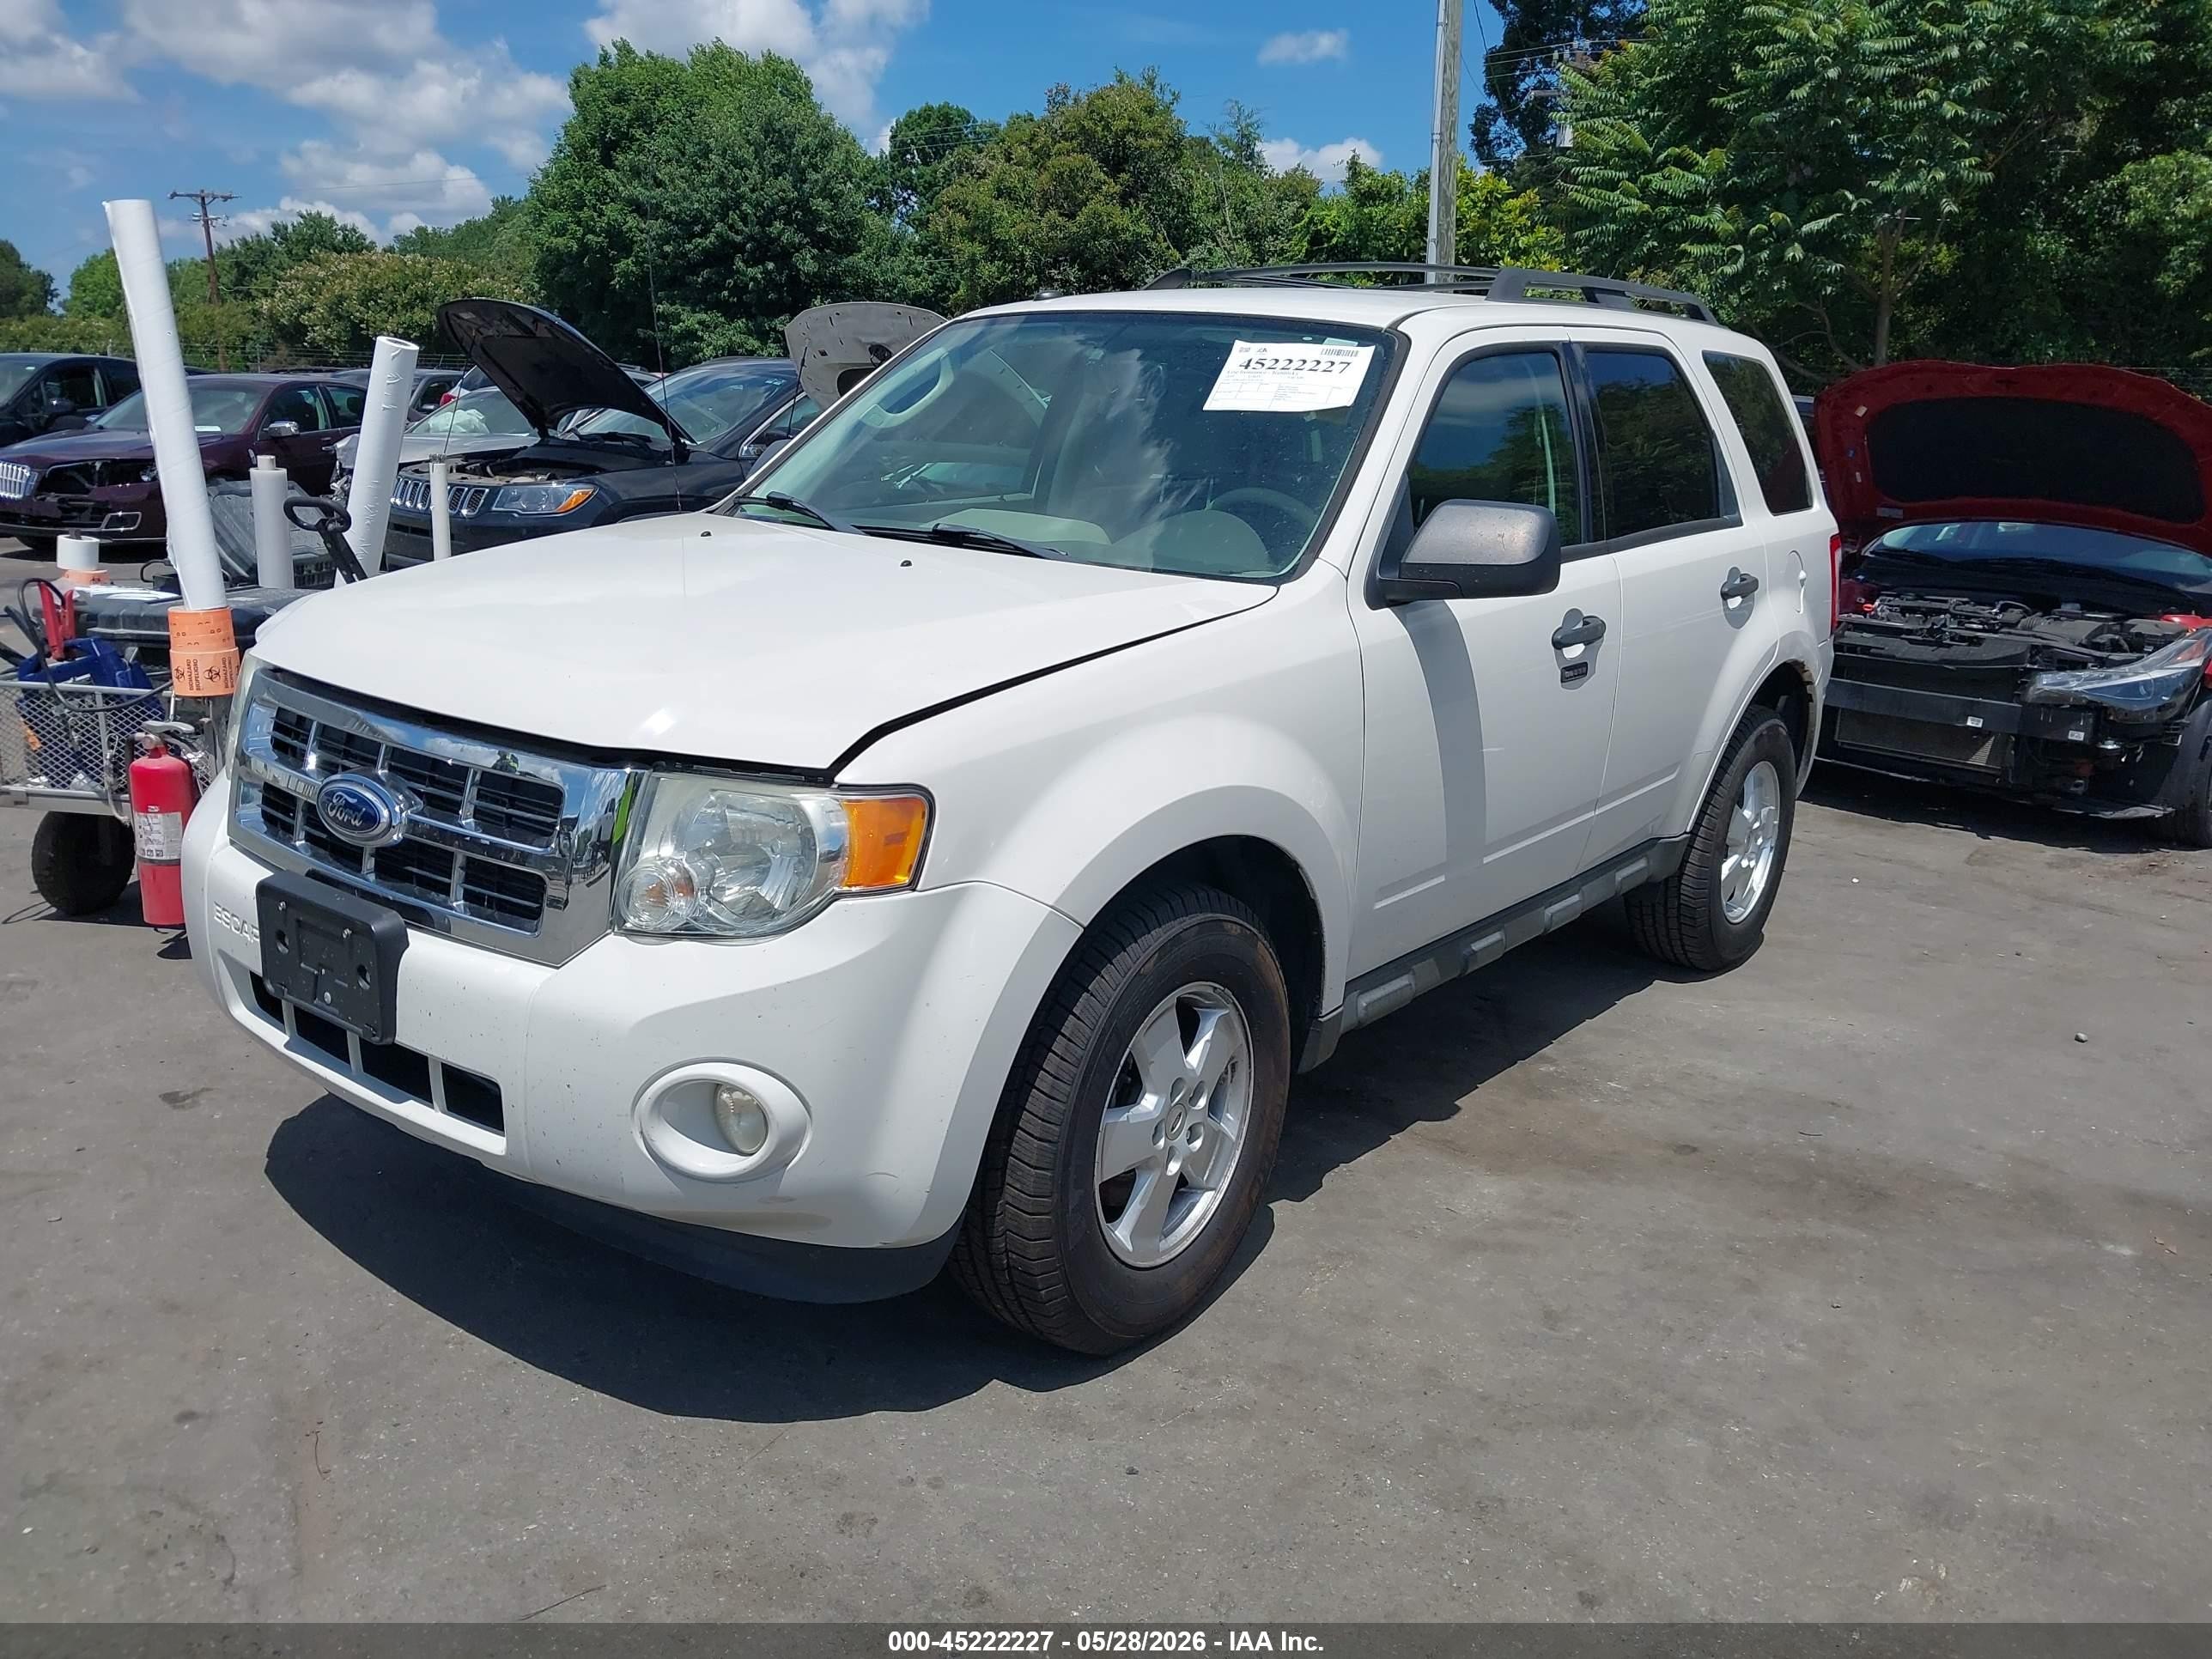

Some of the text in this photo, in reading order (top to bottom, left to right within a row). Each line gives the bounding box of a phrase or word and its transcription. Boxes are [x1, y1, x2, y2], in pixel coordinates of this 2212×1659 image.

[1238, 357, 1353, 374] 45222227
[192, 659, 201, 690] BIOPELIGRO
[327, 792, 366, 827] Ford
[214, 901, 260, 943] ESCAP
